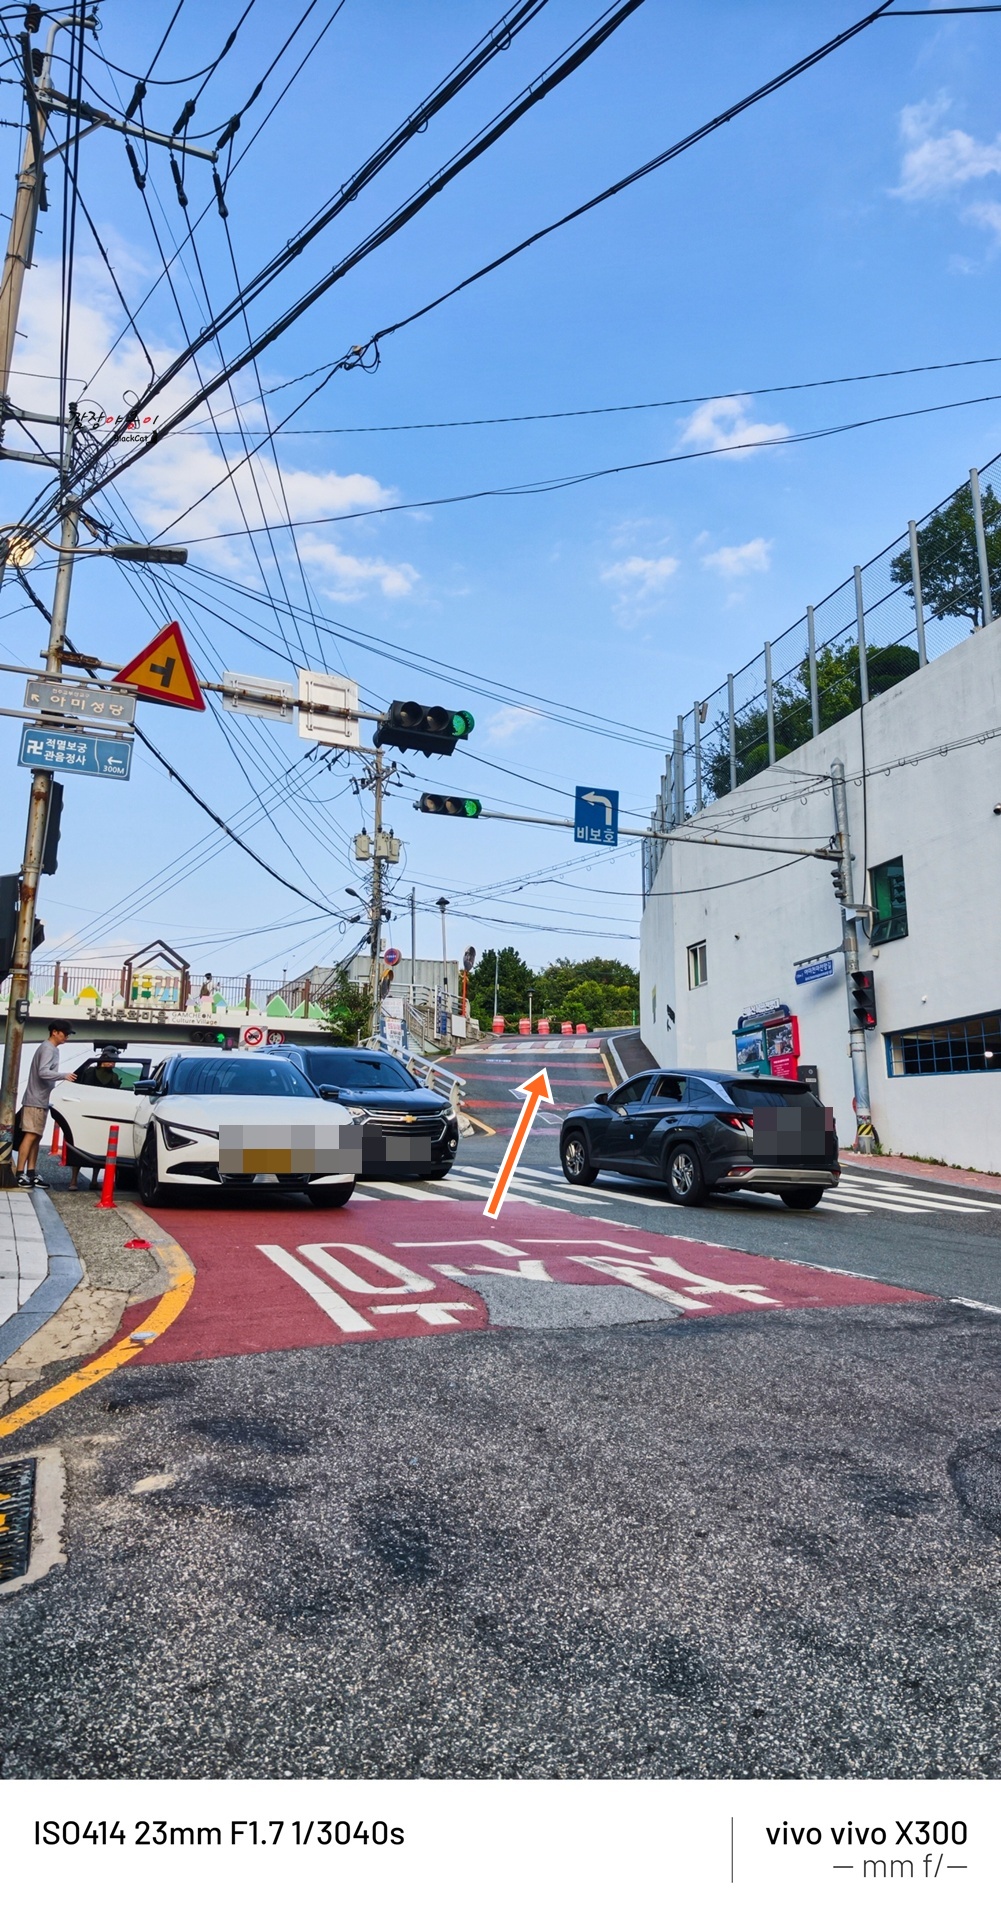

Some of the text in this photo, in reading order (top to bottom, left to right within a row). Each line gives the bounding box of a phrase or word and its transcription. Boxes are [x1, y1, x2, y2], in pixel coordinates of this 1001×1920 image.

[50, 695, 125, 716] 아미성당
[46, 738, 88, 754] 적멸보궁
[44, 750, 87, 766] 관음정사
[103, 765, 125, 775] 300M
[577, 826, 615, 843] 비보호
[87, 1007, 169, 1024] 감천문화마을
